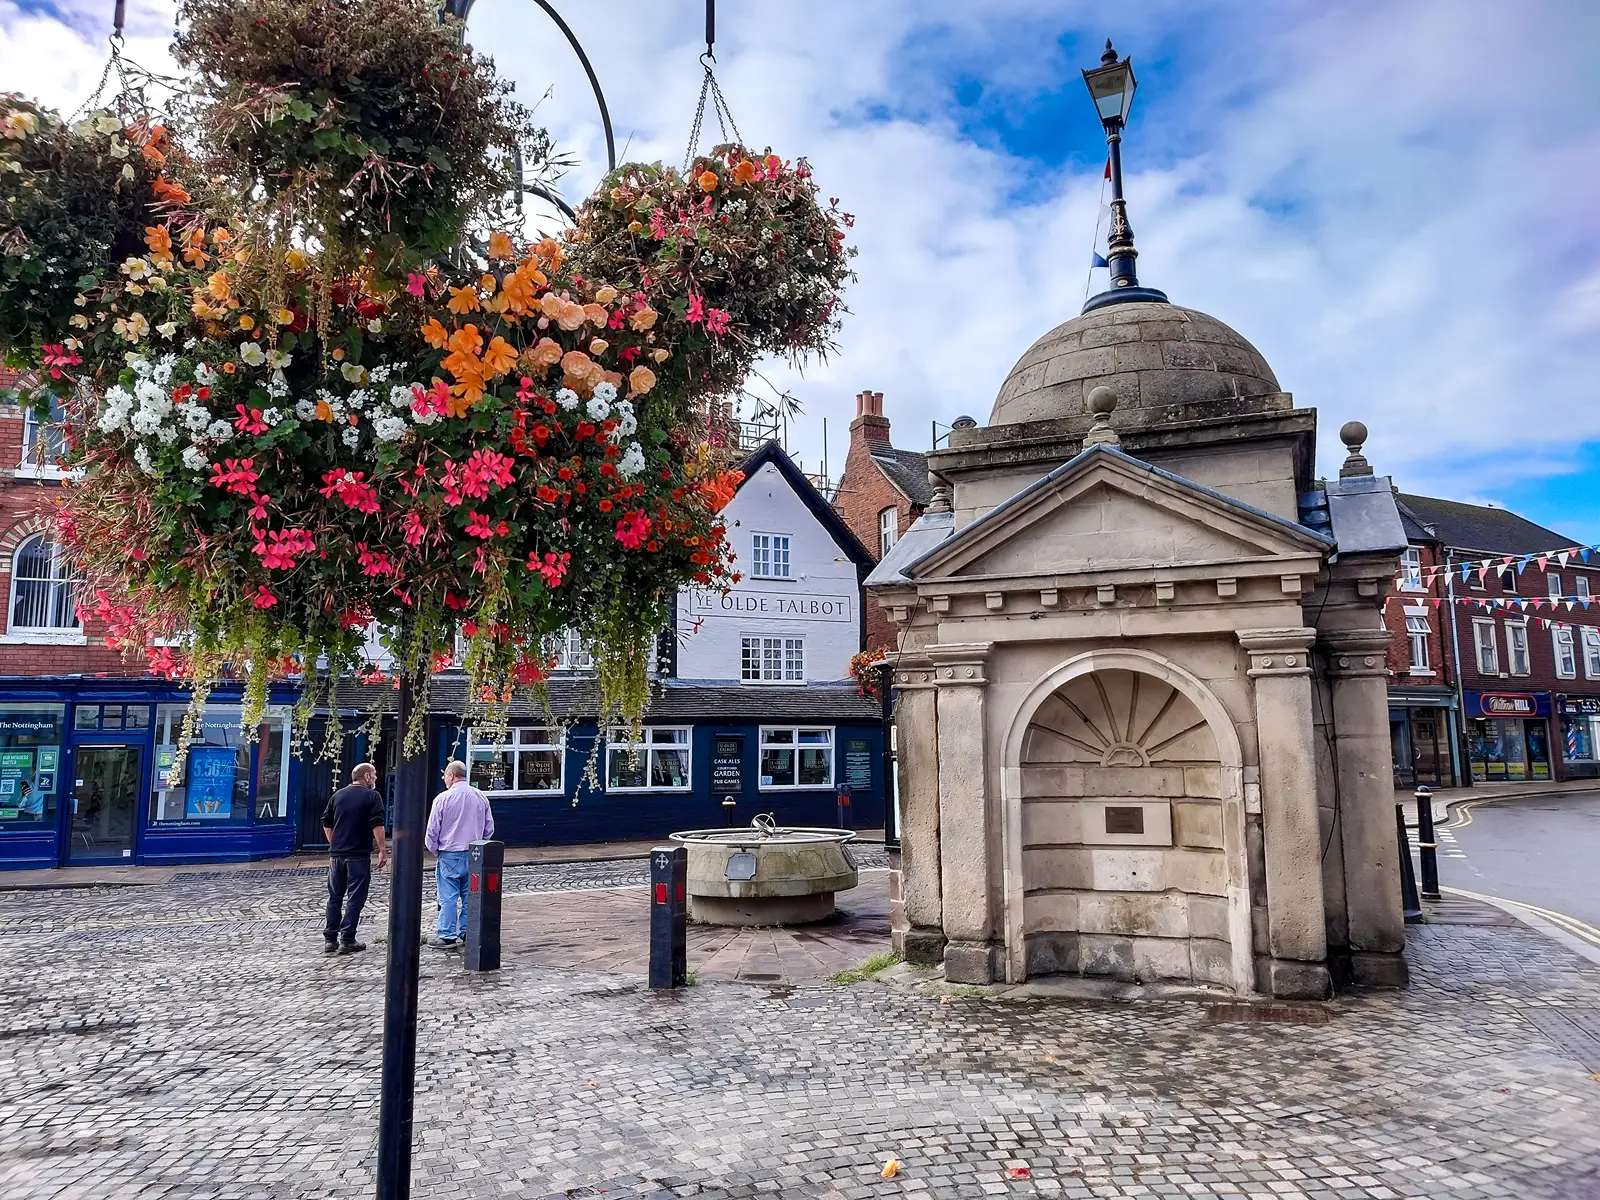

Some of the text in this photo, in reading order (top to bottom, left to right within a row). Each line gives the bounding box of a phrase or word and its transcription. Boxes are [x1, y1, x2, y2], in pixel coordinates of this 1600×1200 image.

[697, 595, 845, 615] YE OLDE TALBOT
[1514, 699, 1530, 711] HILL
[0, 721, 54, 730] The Nottingham
